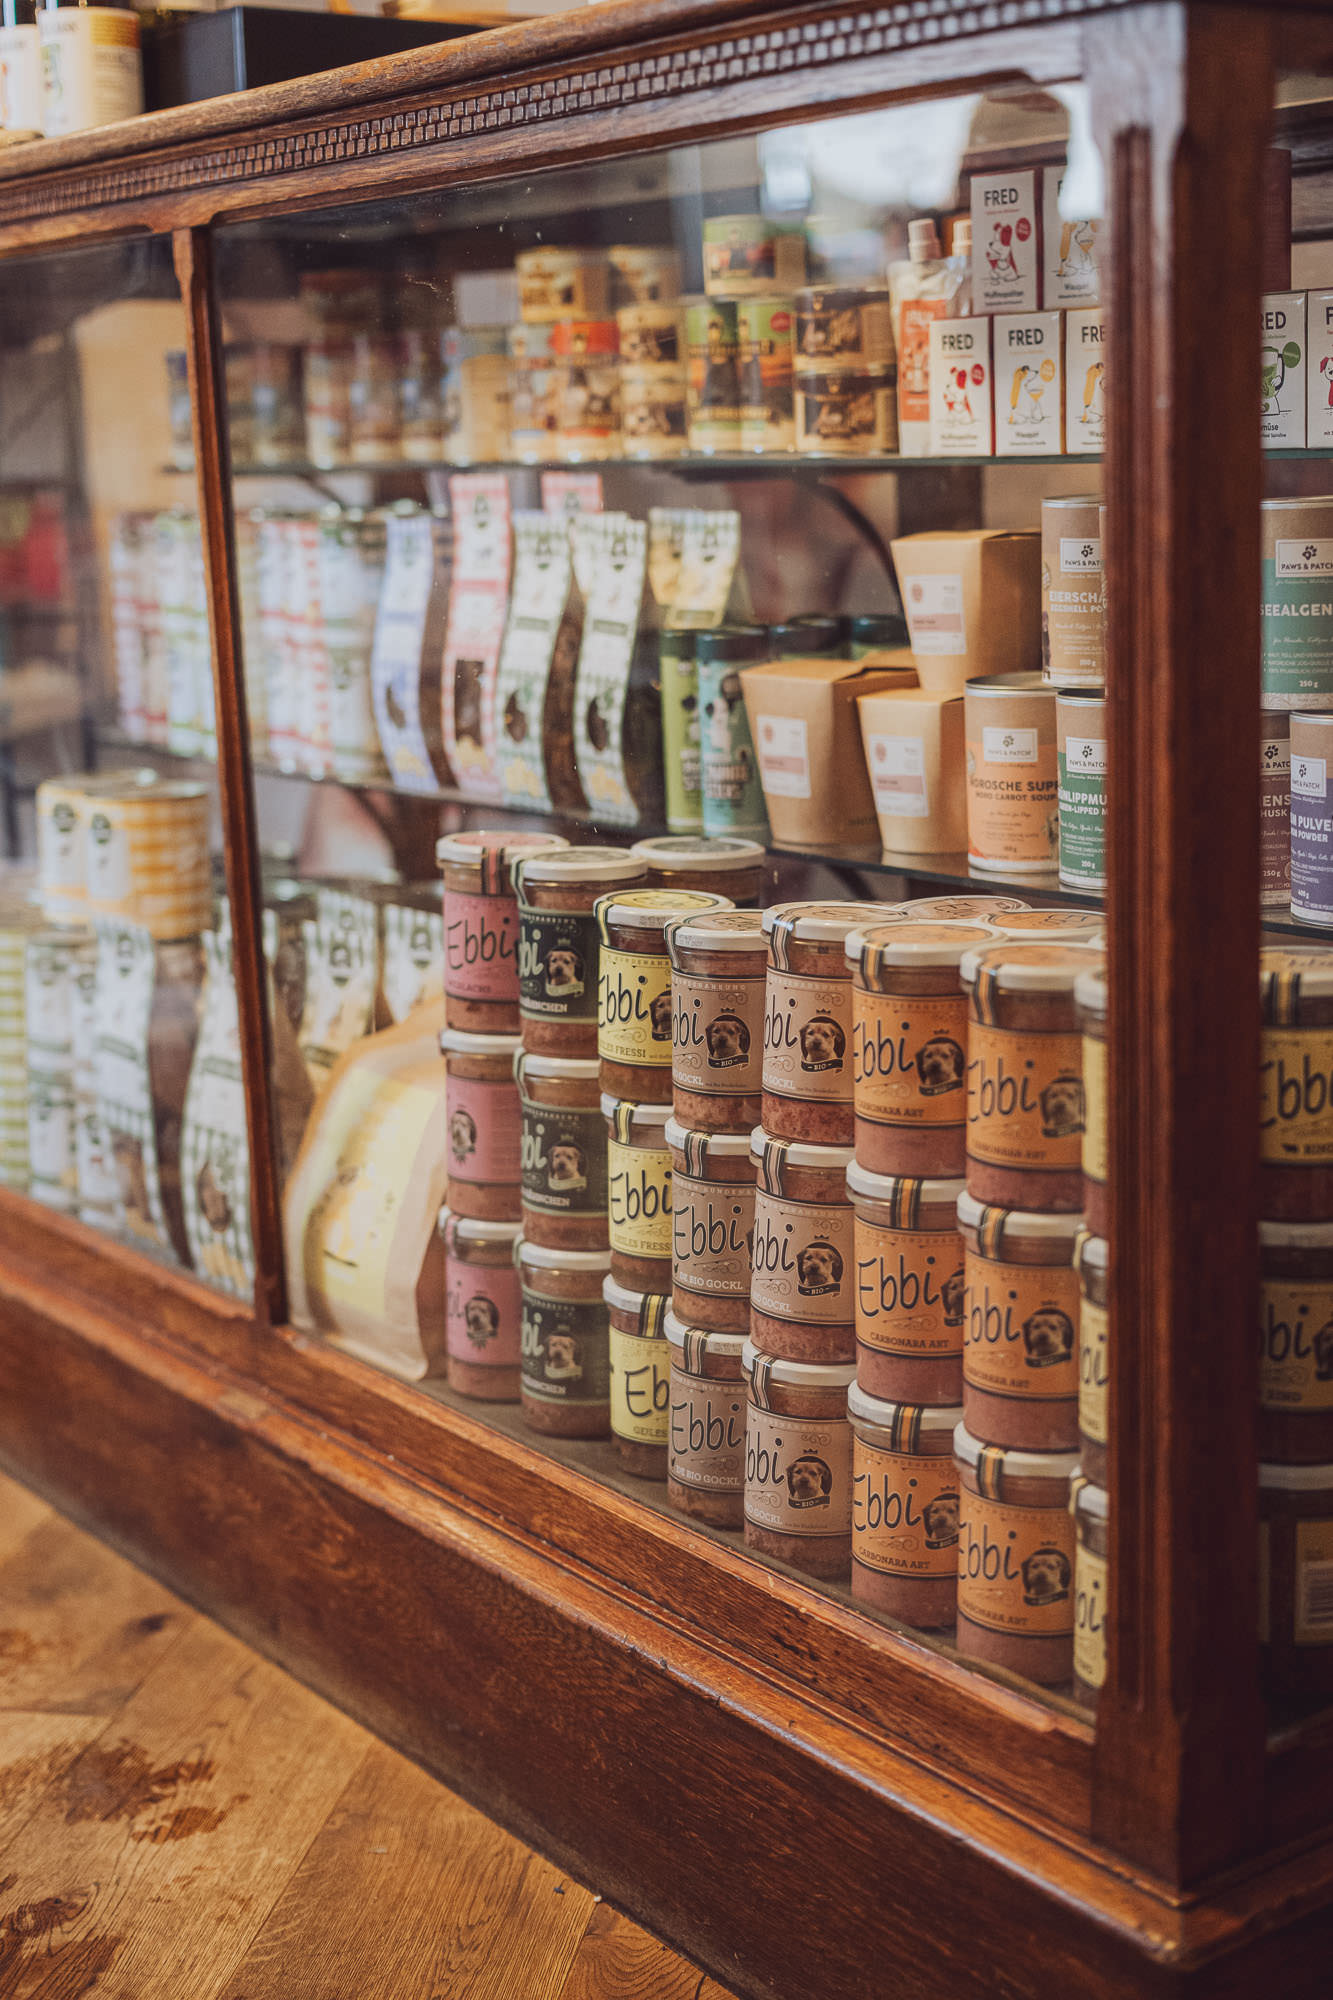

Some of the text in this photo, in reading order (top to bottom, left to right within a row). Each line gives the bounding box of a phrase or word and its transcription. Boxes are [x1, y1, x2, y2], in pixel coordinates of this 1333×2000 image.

[984, 188, 1019, 207] FRED
[941, 334, 974, 351] FRED
[1008, 328, 1044, 347] FRED
[1081, 325, 1104, 343] FRE
[448, 916, 513, 970] Ebbi
[721, 1058, 733, 1066] BIO
[674, 1203, 745, 1261] Ebbi
[705, 1279, 744, 1291] GOCKL
[811, 1286, 824, 1295] BIO
[858, 1253, 939, 1317] Ebbi
[870, 1331, 950, 1349] CARBONARA ART
[624, 1364, 670, 1418] Eb
[671, 1400, 742, 1456] Ebbi
[703, 1473, 740, 1486] GOCKL
[801, 1499, 814, 1507] BIO
[854, 1472, 922, 1532] Ebbi
[859, 1546, 931, 1570] CARBONARA ART
